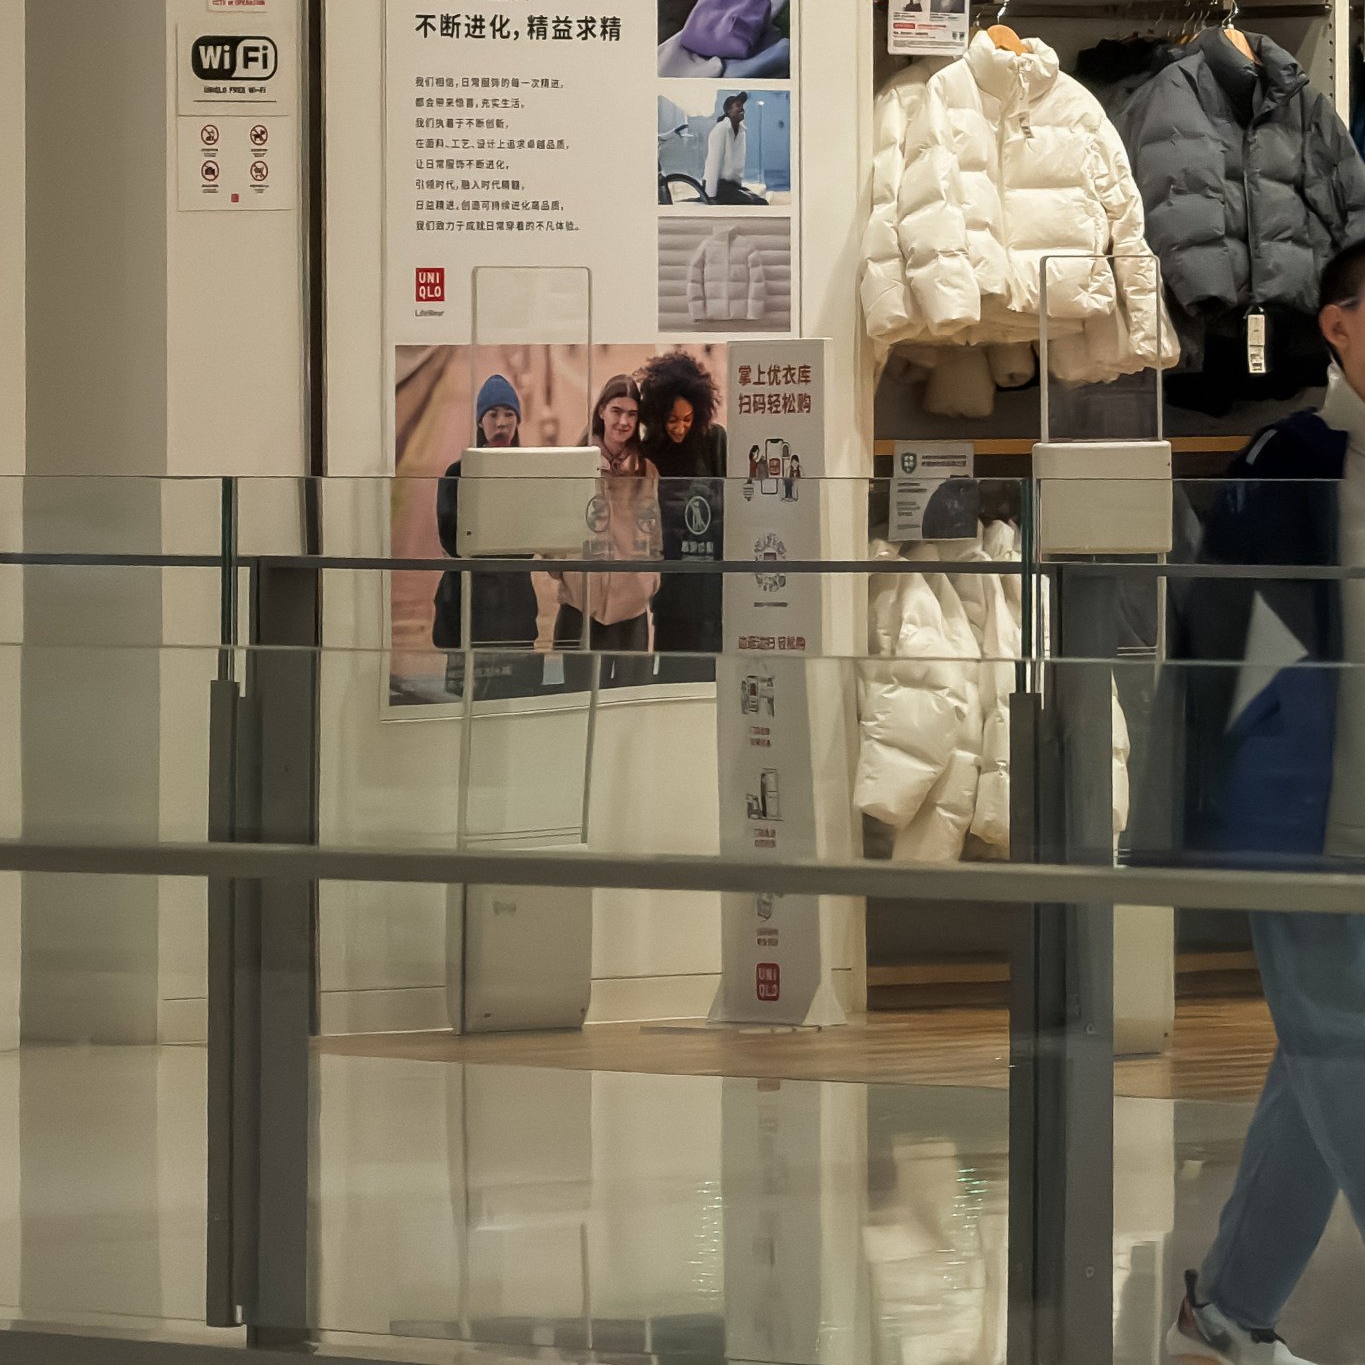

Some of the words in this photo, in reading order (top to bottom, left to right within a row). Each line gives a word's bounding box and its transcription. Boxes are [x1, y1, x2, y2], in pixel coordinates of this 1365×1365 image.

[415, 13, 622, 42] 不断进化，精益求精
[418, 272, 440, 284] UNI
[419, 286, 442, 299] QLO
[738, 363, 812, 386] 掌上优衣库
[738, 392, 812, 415] 扫码轻松购
